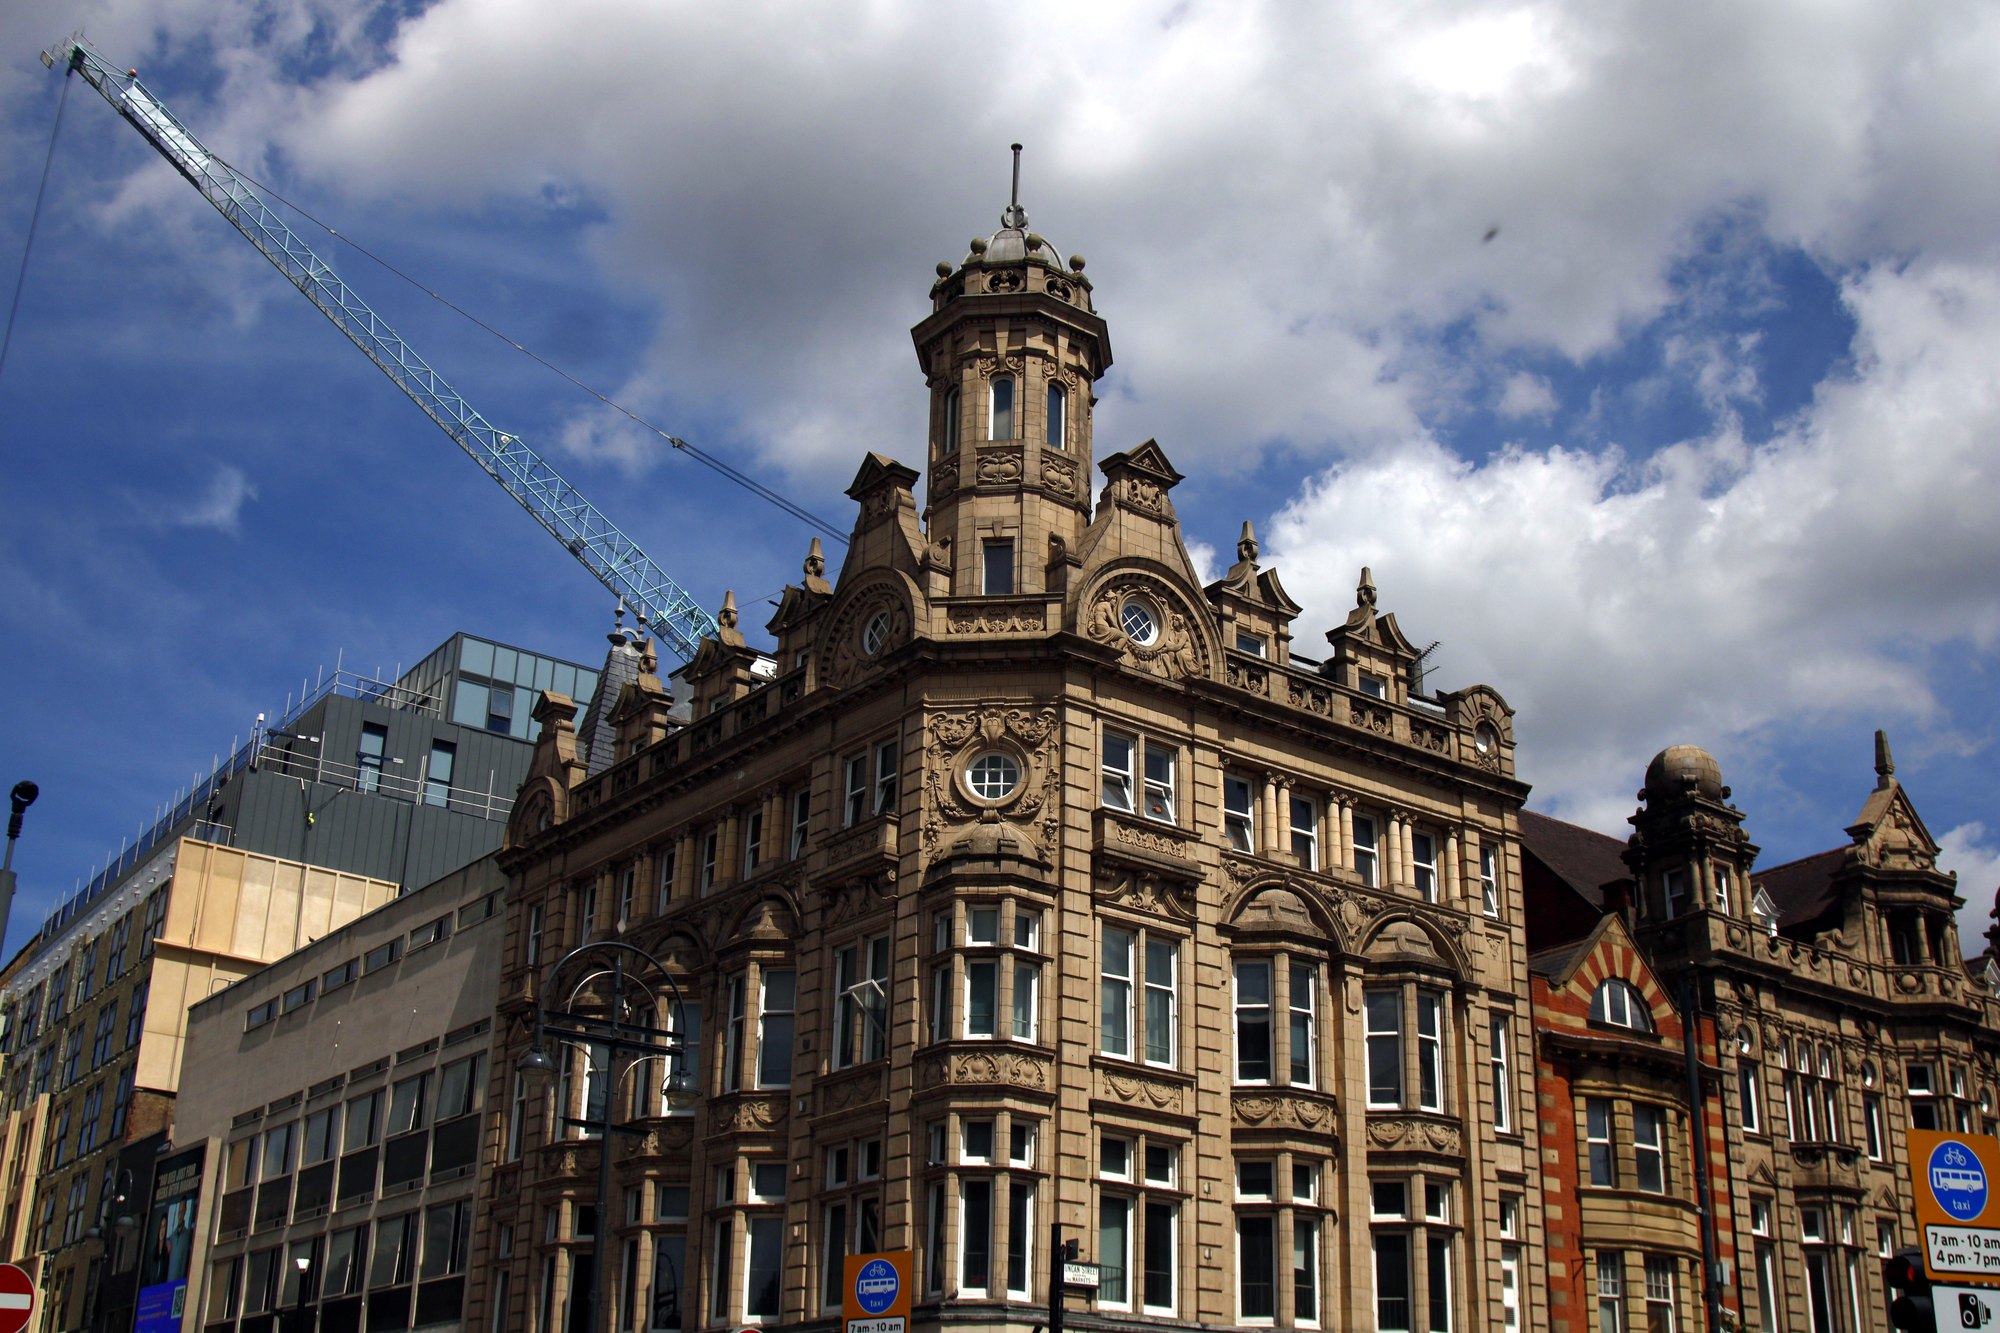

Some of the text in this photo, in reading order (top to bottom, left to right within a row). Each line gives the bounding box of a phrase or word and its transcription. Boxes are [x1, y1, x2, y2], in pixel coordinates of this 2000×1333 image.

[1953, 1199, 1971, 1210] taxi
[1930, 1232, 1938, 1245] 7
[1941, 1235, 1959, 1247] am
[1967, 1234, 1981, 1248] 10
[1984, 1238, 2000, 1249] am
[1936, 1249, 1945, 1263] 4
[1947, 1253, 1966, 1266] pm
[1973, 1251, 1981, 1265] 7
[1983, 1255, 2000, 1268] pm
[1065, 1264, 1080, 1273] UNCAN
[1081, 1265, 1098, 1275] STREET
[850, 1324, 856, 1333] 7
[857, 1325, 869, 1333] am
[876, 1322, 887, 1332] 10
[888, 1323, 901, 1331] am
